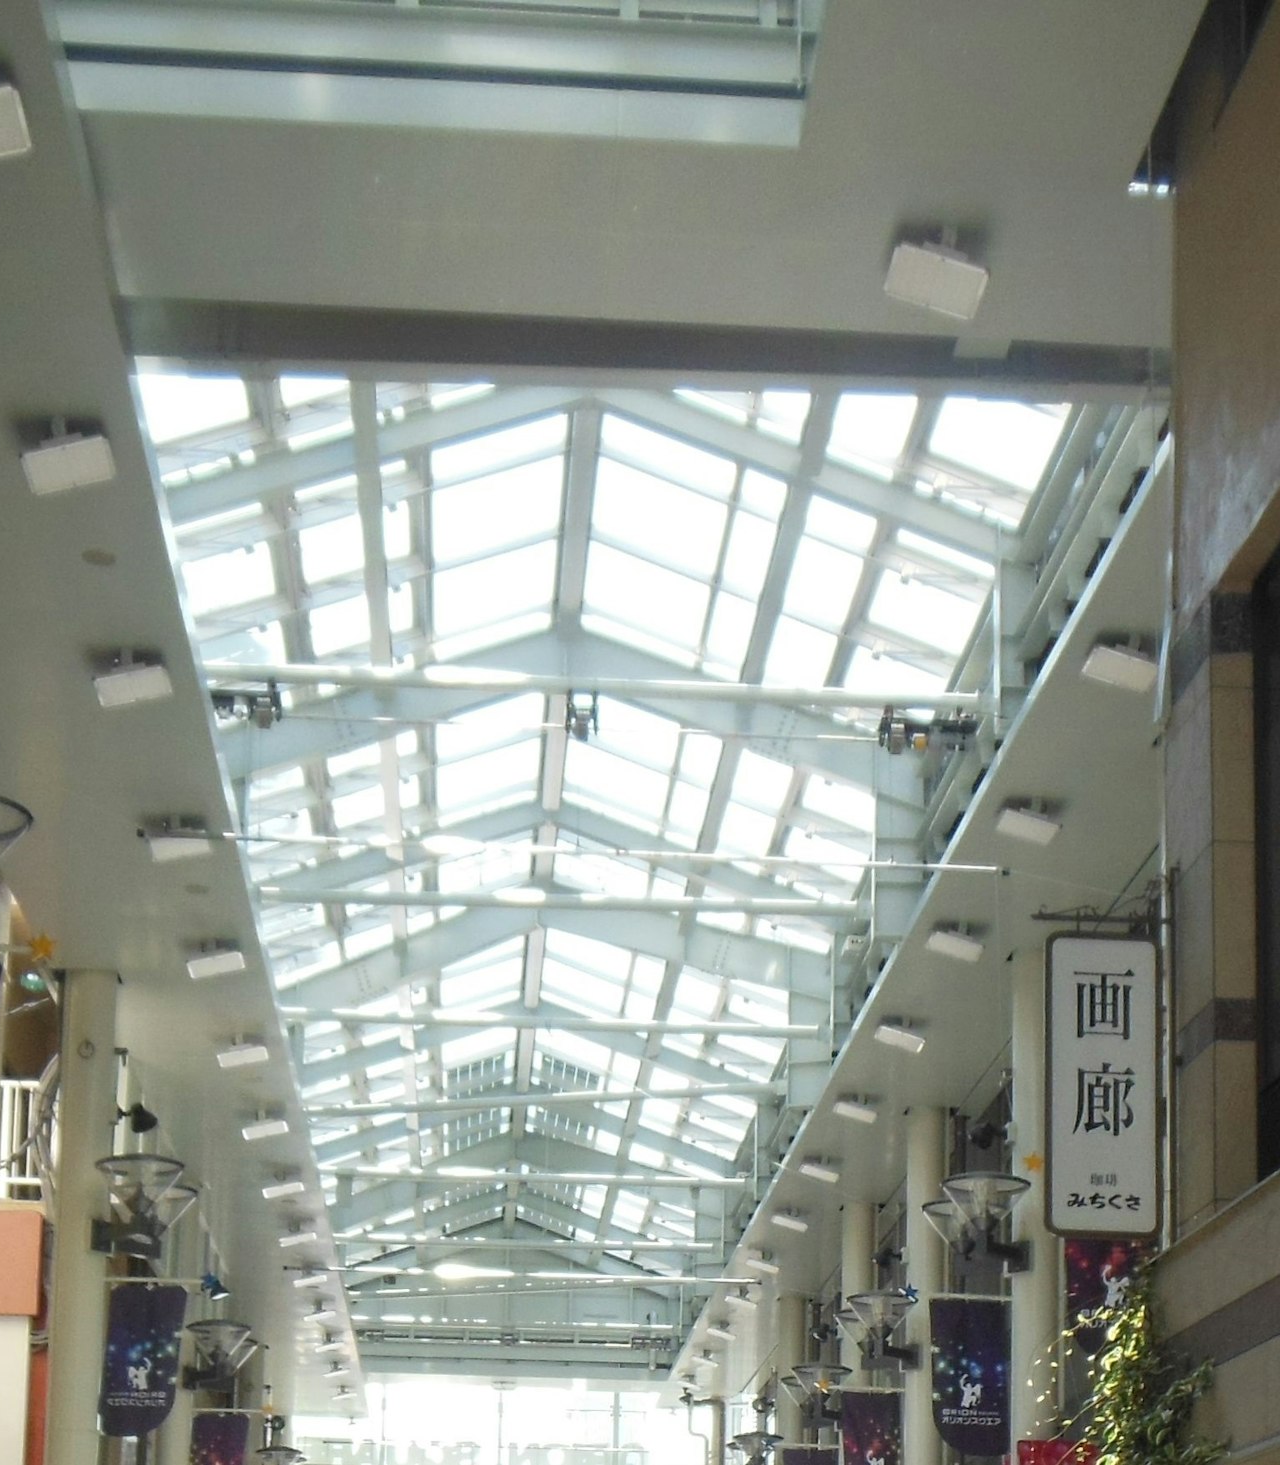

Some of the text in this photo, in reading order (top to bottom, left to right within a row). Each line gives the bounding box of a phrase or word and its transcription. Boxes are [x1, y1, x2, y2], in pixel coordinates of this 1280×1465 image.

[1073, 968, 1135, 1136] 画廊
[1067, 1192, 1141, 1211] みちくさ
